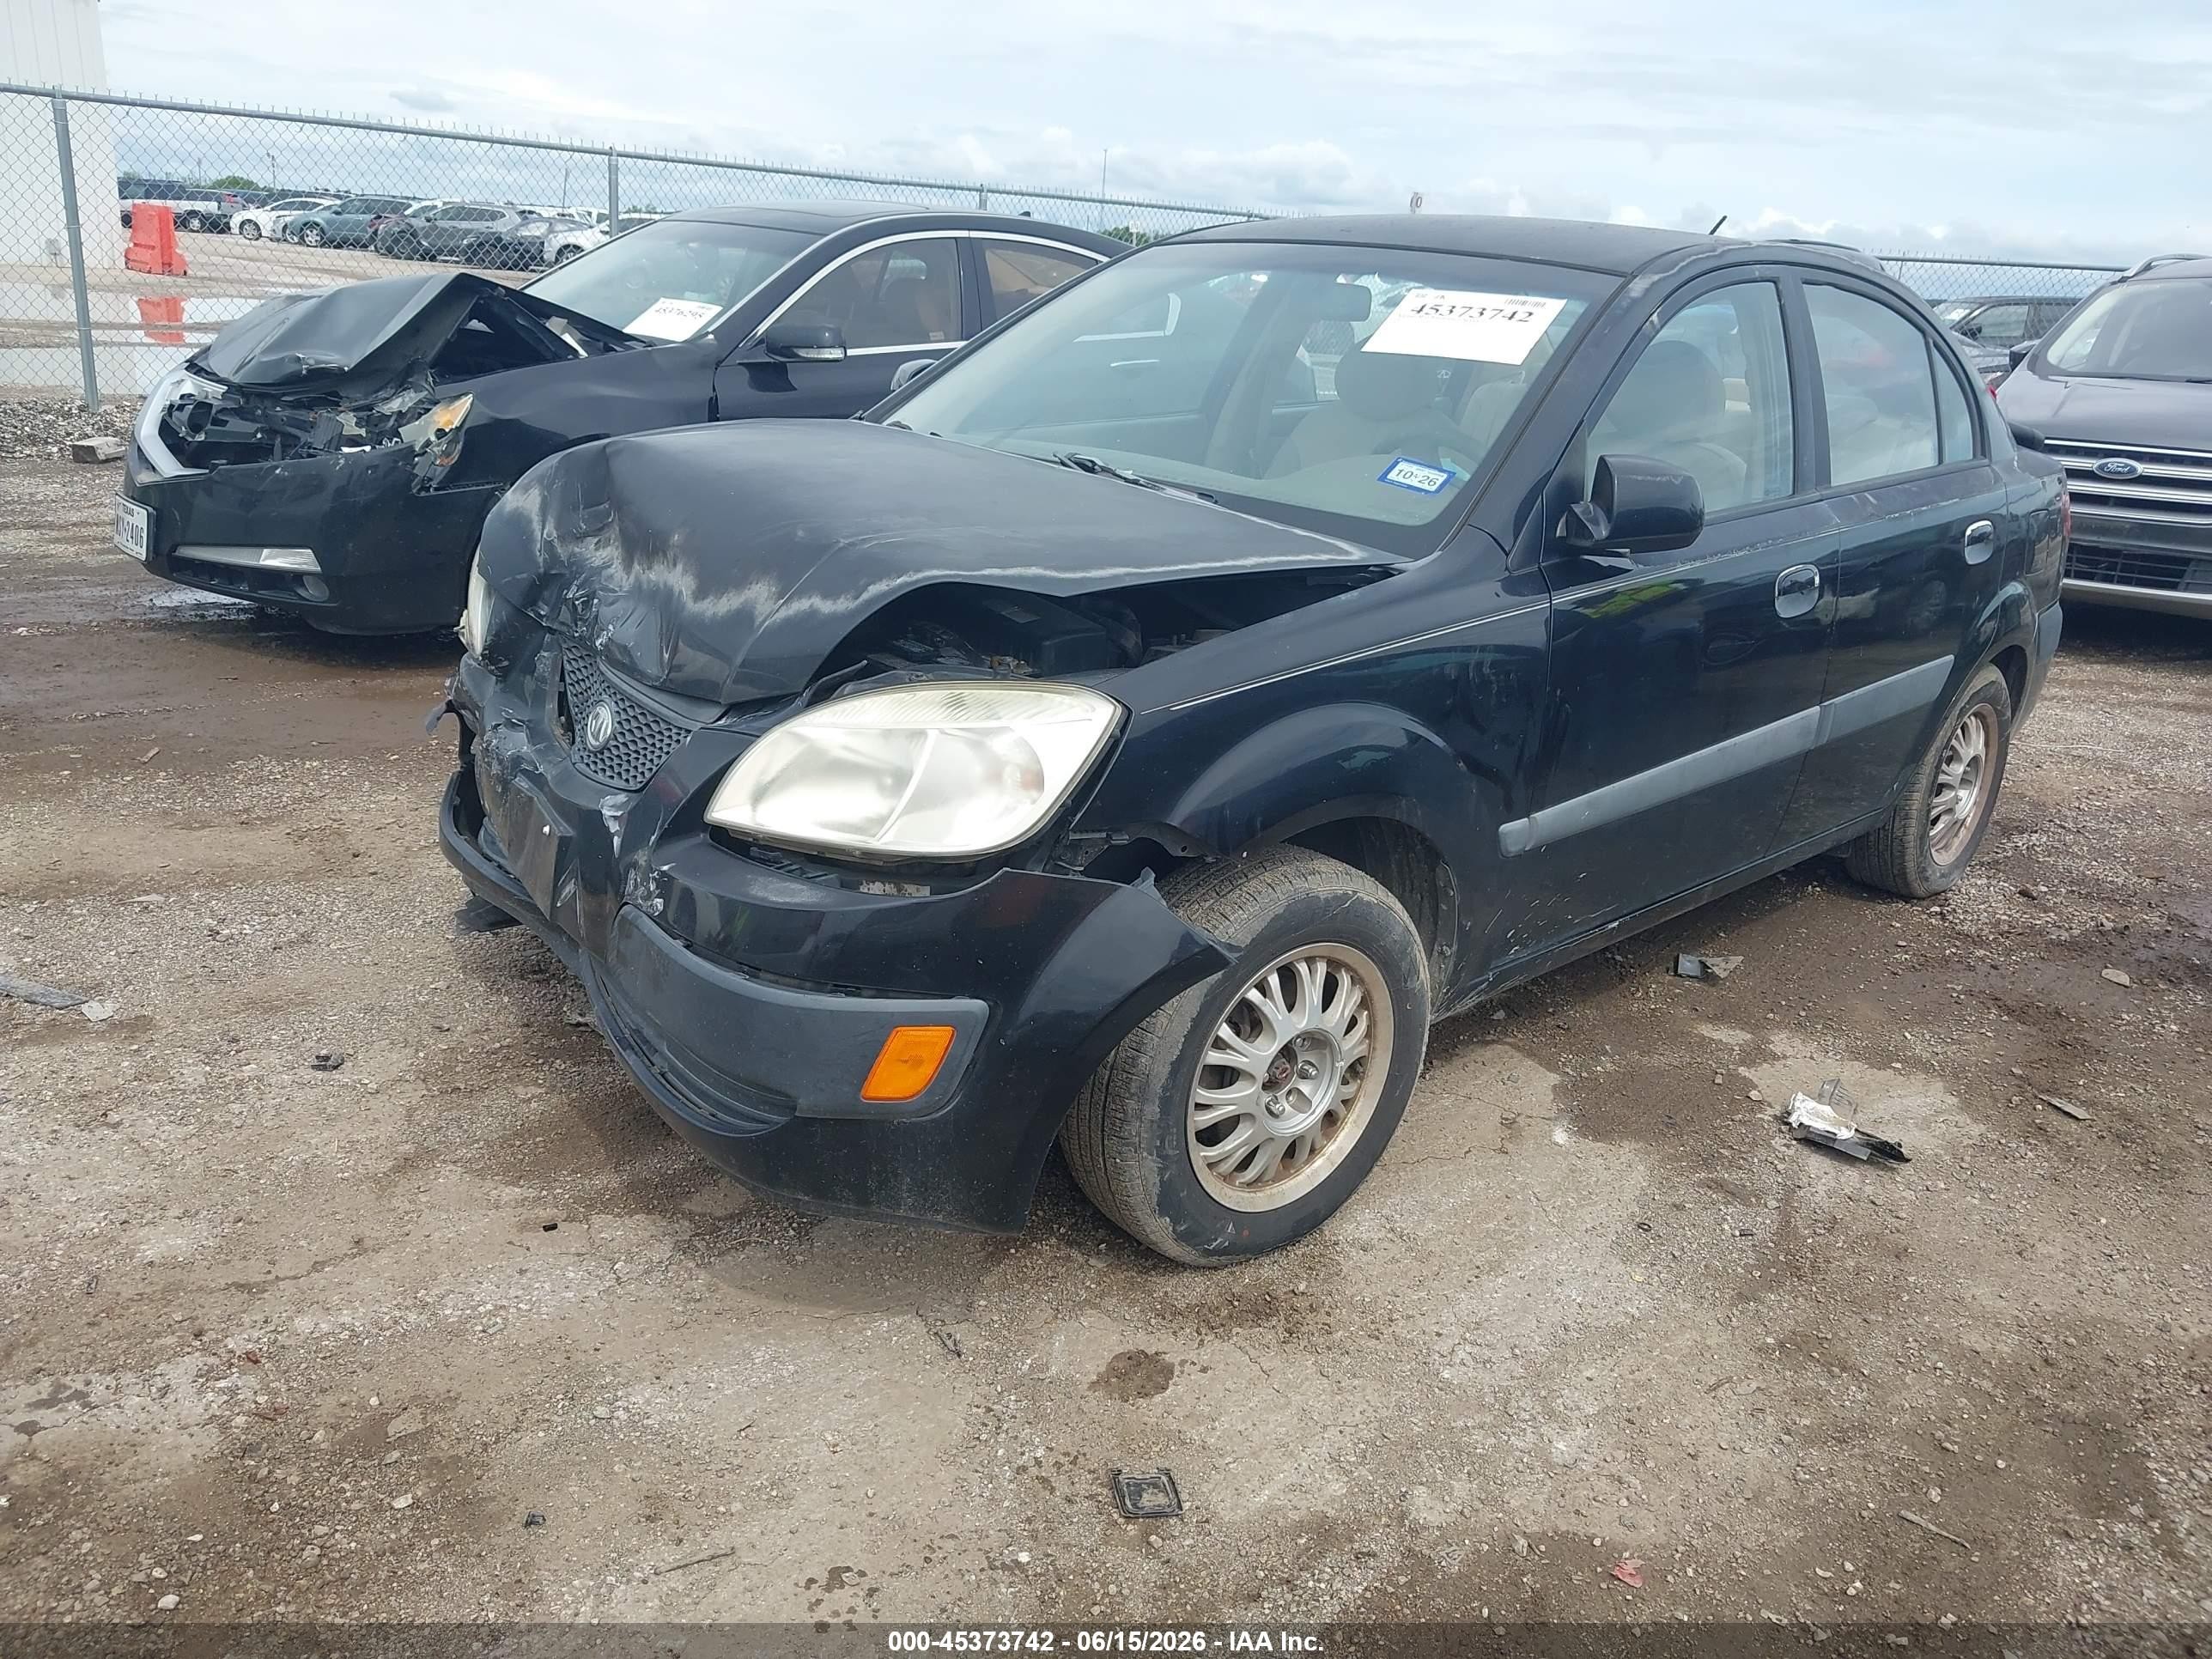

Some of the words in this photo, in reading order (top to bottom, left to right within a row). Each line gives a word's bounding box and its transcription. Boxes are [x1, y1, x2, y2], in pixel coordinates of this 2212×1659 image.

[1410, 302, 1534, 323] 45373742
[2104, 462, 2130, 474] Ford
[122, 502, 135, 518] TEXAS
